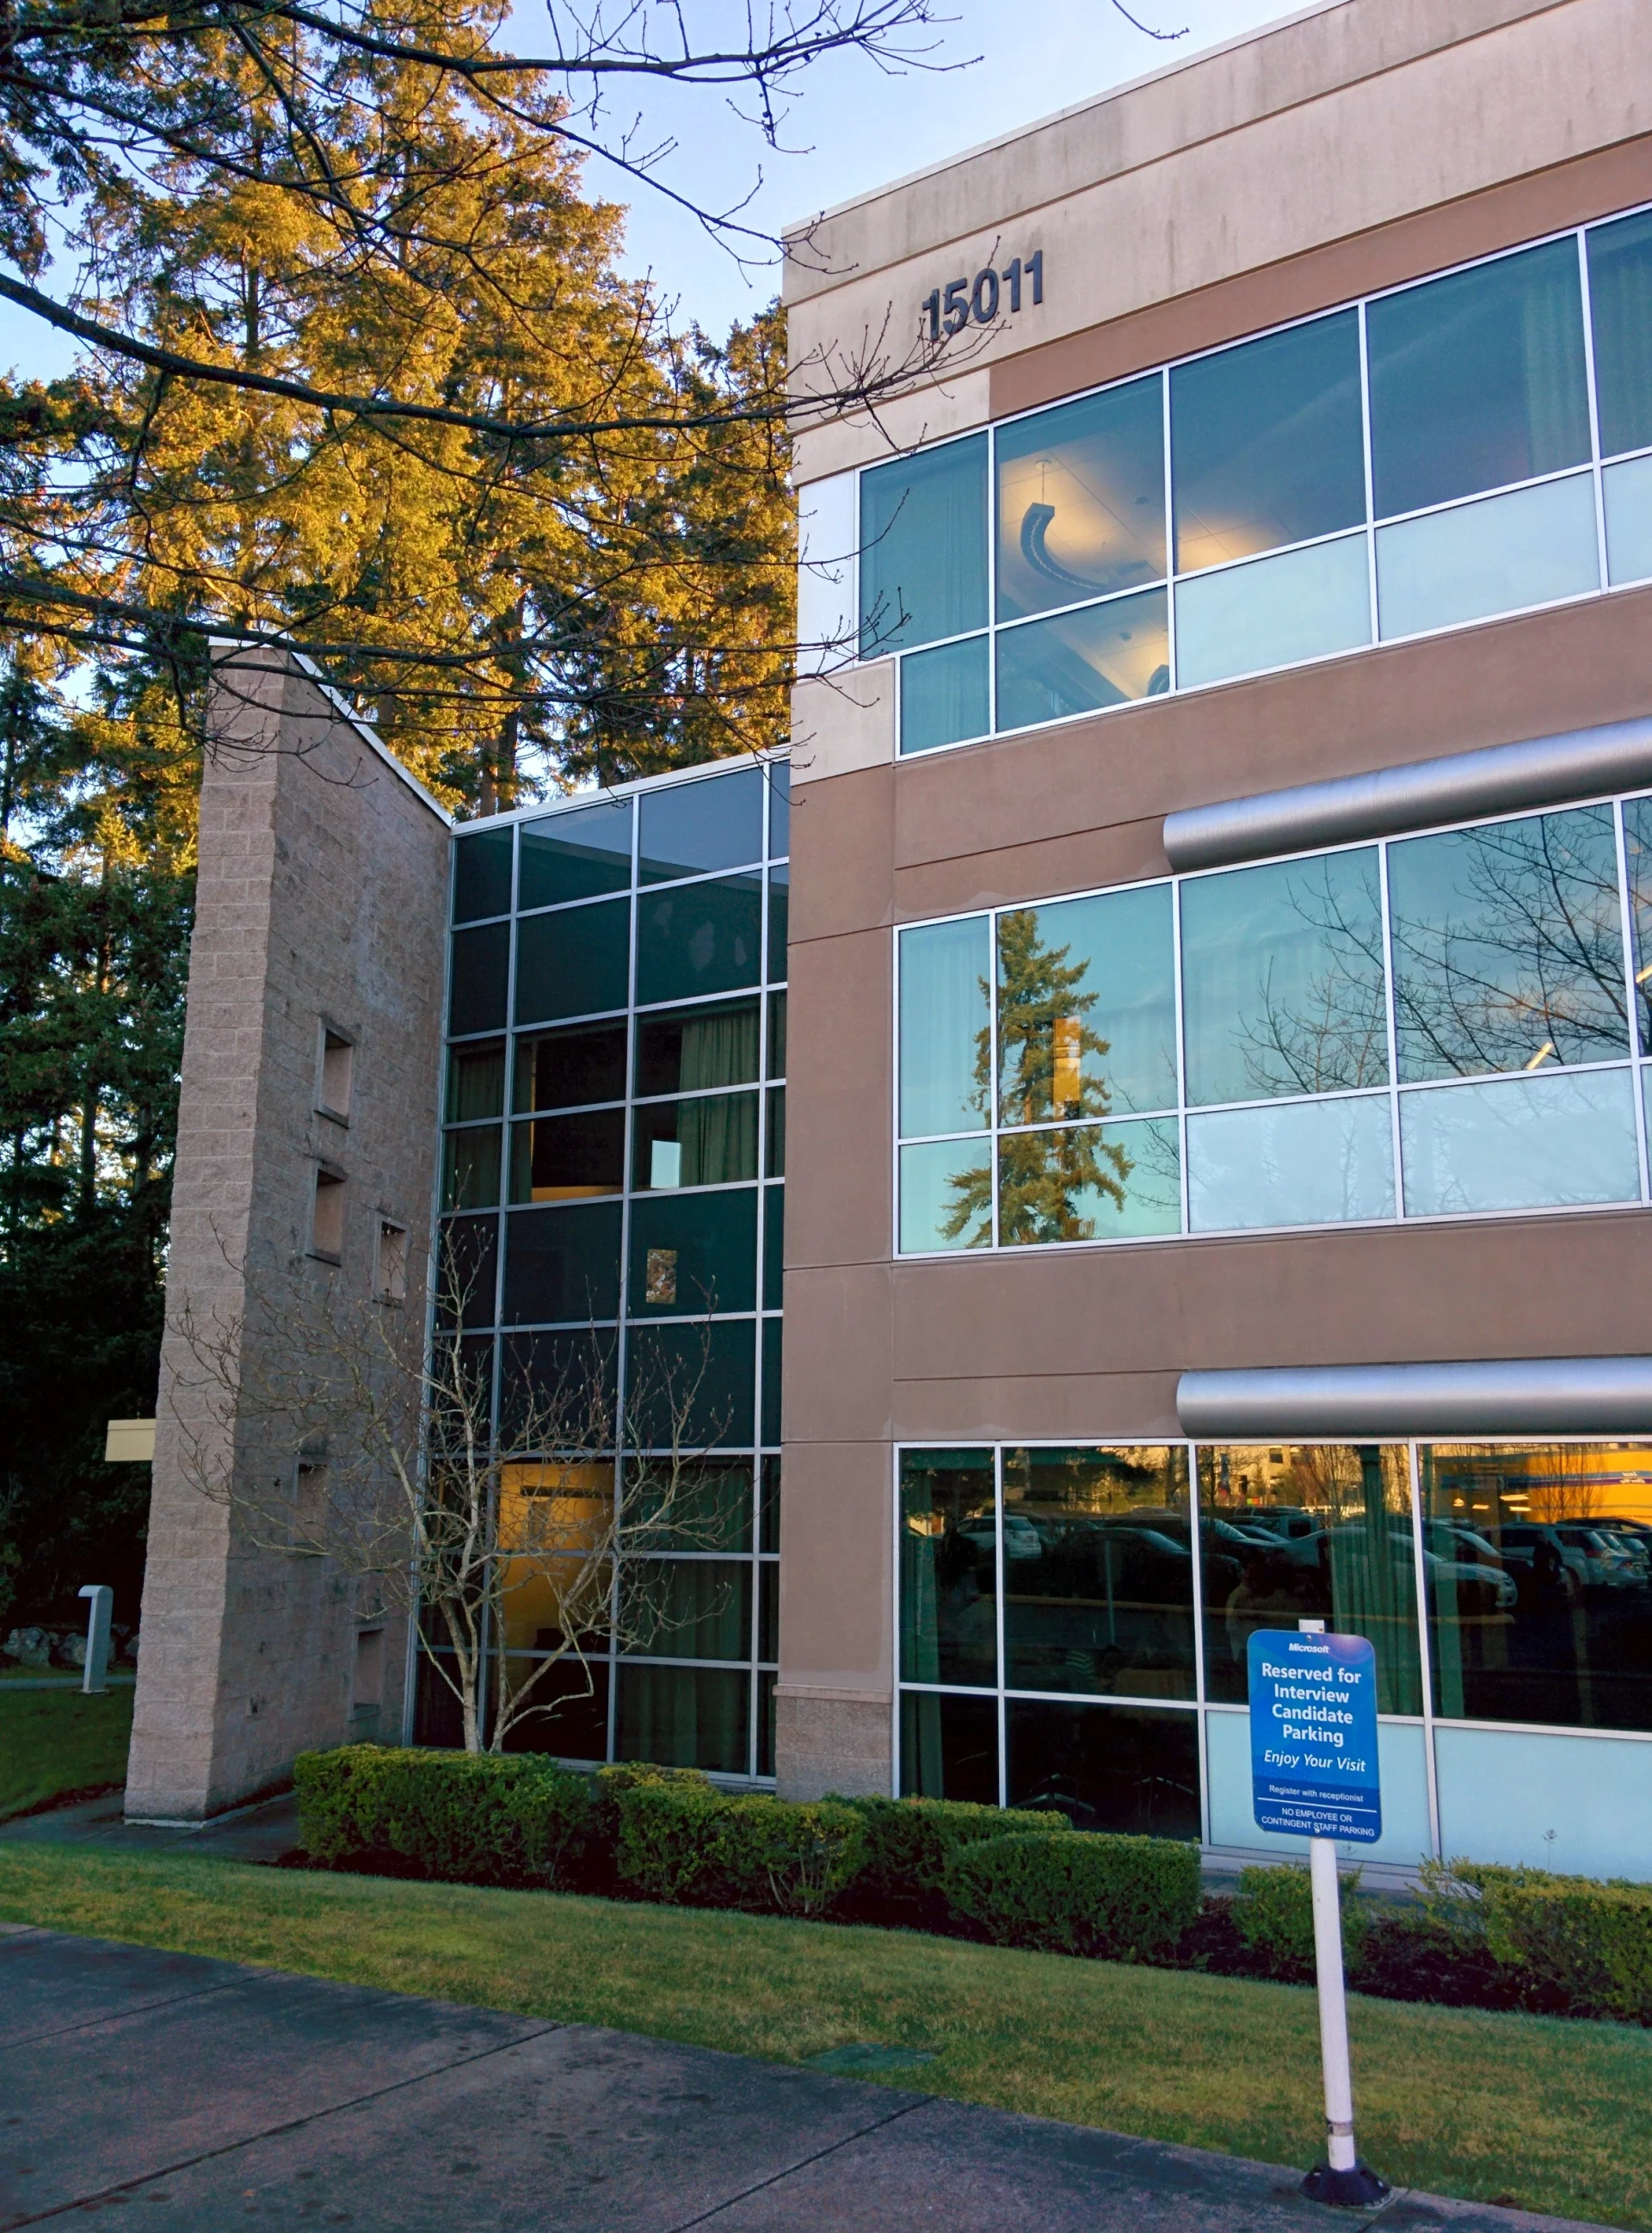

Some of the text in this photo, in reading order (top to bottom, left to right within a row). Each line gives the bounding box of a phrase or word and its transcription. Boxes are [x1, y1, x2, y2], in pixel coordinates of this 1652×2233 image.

[922, 249, 1043, 342] 15011
[1288, 1643, 1329, 1653] Microsoft
[1261, 1662, 1362, 1684] Reserved for
[1274, 1683, 1349, 1704] Interview
[1272, 1703, 1353, 1724] Candidate
[1283, 1724, 1345, 1748] Parking
[1264, 1749, 1366, 1773] Enjoy Your Visit
[1269, 1785, 1364, 1802] Register with receptionist
[1261, 1816, 1375, 1836] CONTINGENT STAFF PARKING
[1296, 1809, 1338, 1822] EMPLOYEE
